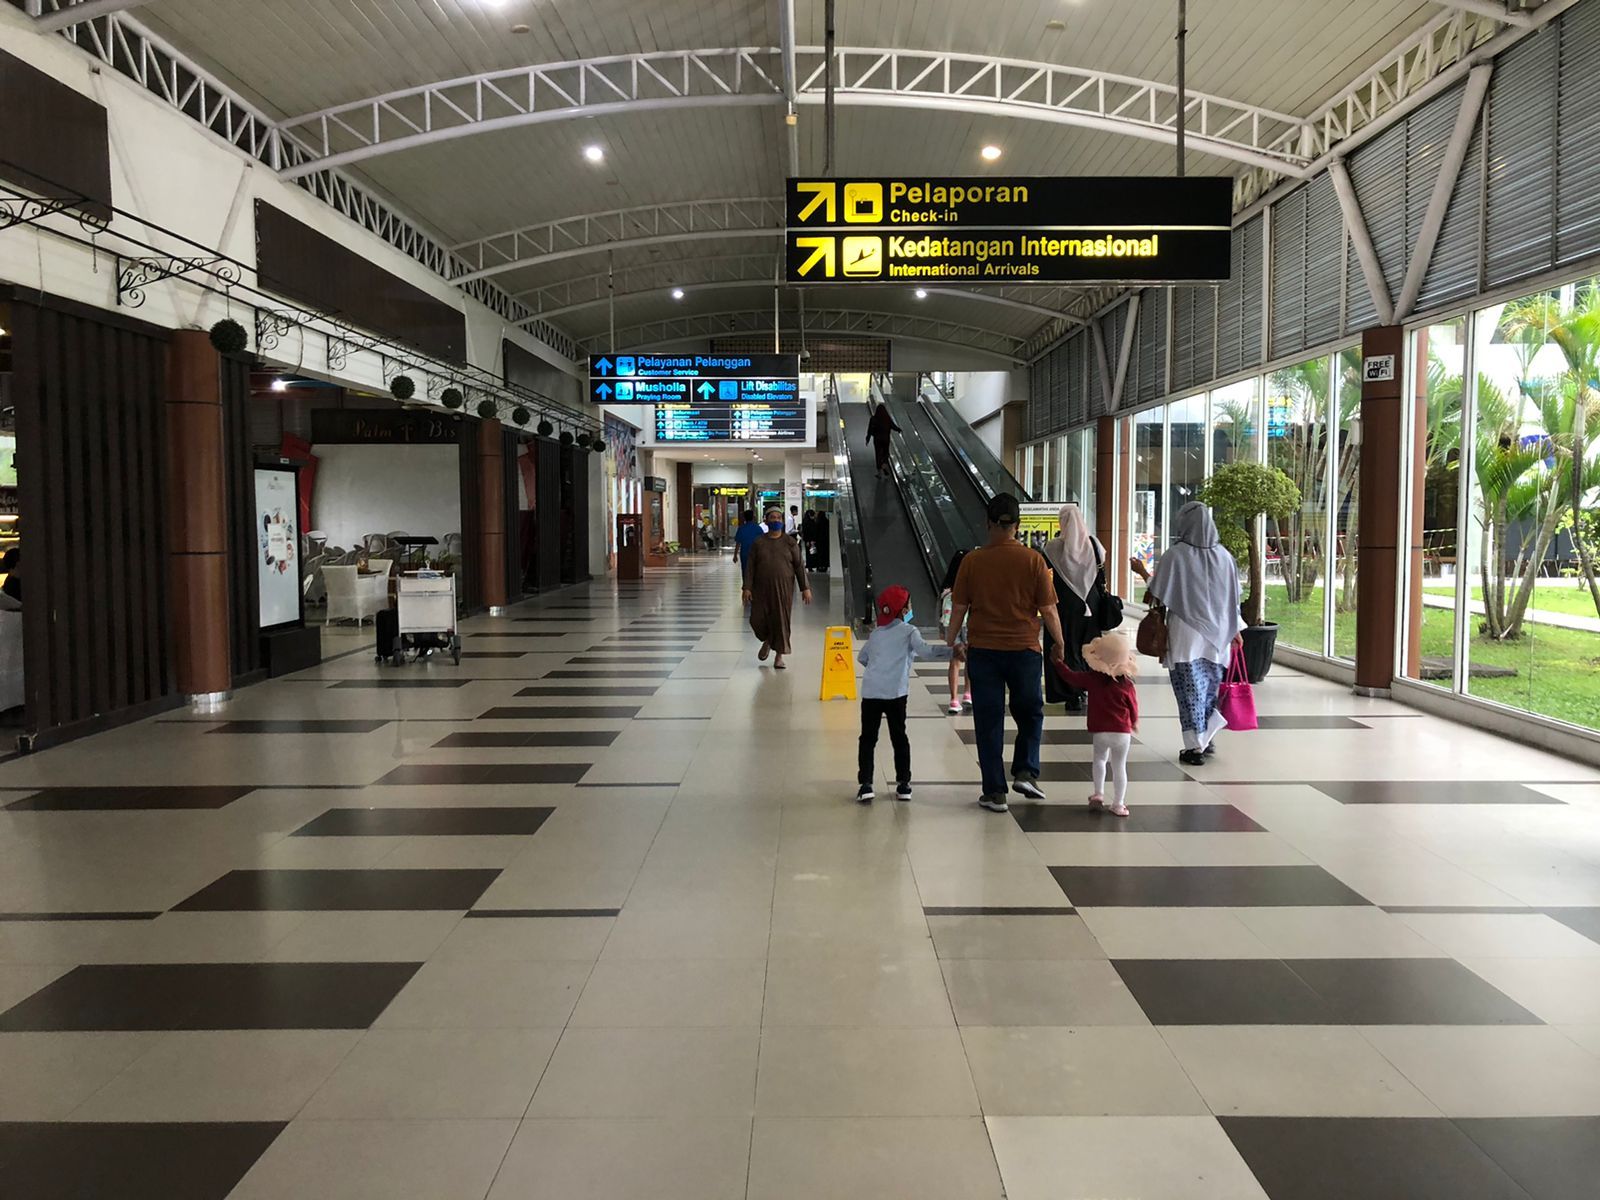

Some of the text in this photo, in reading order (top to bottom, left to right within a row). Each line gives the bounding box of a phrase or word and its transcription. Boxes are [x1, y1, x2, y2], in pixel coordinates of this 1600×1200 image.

[890, 182, 1029, 208] Pelaporan
[890, 209, 959, 222] Check-in
[889, 234, 1159, 262] Kedatangan Internasional
[889, 262, 1040, 276] International Arrivals
[638, 356, 751, 369] Pelayanan Pelanggan
[1367, 360, 1390, 368] FREE
[635, 382, 686, 392] Musholla
[741, 381, 797, 391] Lift Disabilitas
[766, 393, 793, 401] Elevators
